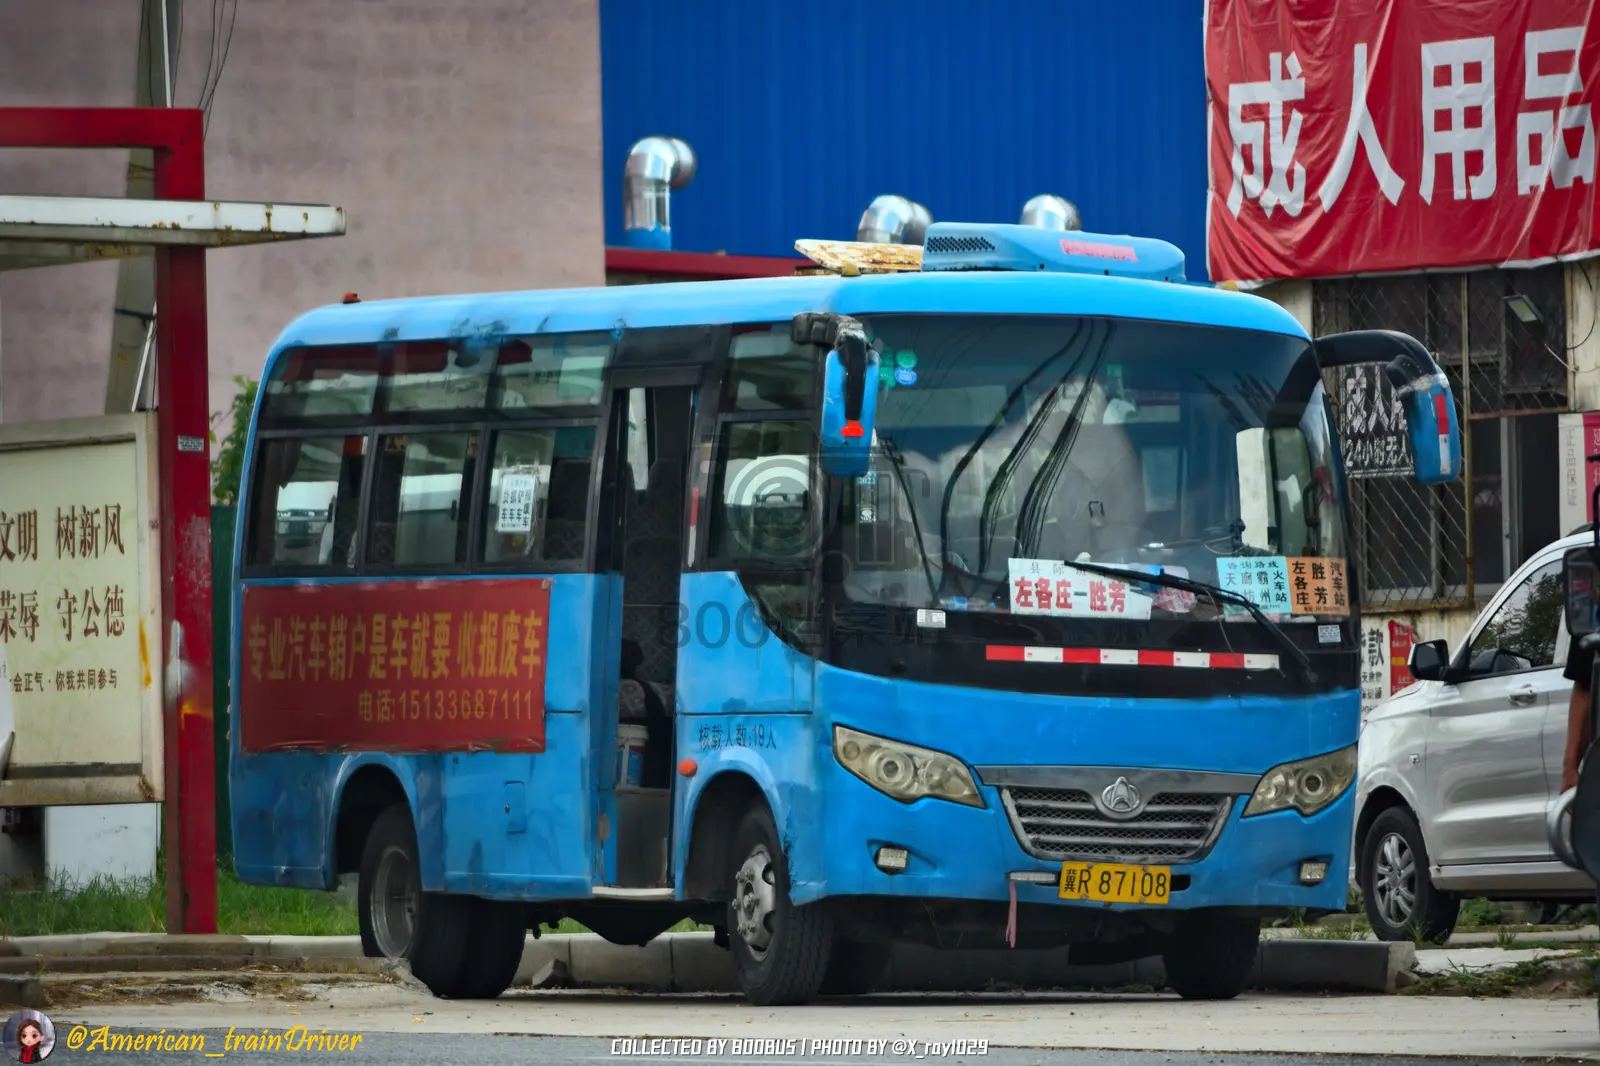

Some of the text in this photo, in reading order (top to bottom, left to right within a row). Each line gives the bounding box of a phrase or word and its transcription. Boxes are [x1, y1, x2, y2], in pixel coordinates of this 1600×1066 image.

[1226, 27, 1595, 220] 成人用品
[1345, 434, 1414, 467] 24小时无人
[1566, 428, 1577, 506] 正品保证
[56, 503, 125, 560] 树新风
[1257, 571, 1271, 603] 霸州
[1273, 570, 1287, 602] 火车站
[1292, 561, 1310, 605] 左各庄
[1312, 562, 1328, 605] 胜芳
[1330, 562, 1345, 606] 汽车站
[57, 584, 125, 642] 守公德
[248, 608, 542, 682] 专业汽车销户是车就要 收报废车
[9, 669, 118, 693] 会正气·你我共同参与
[1098, 870, 1168, 898] 87108
